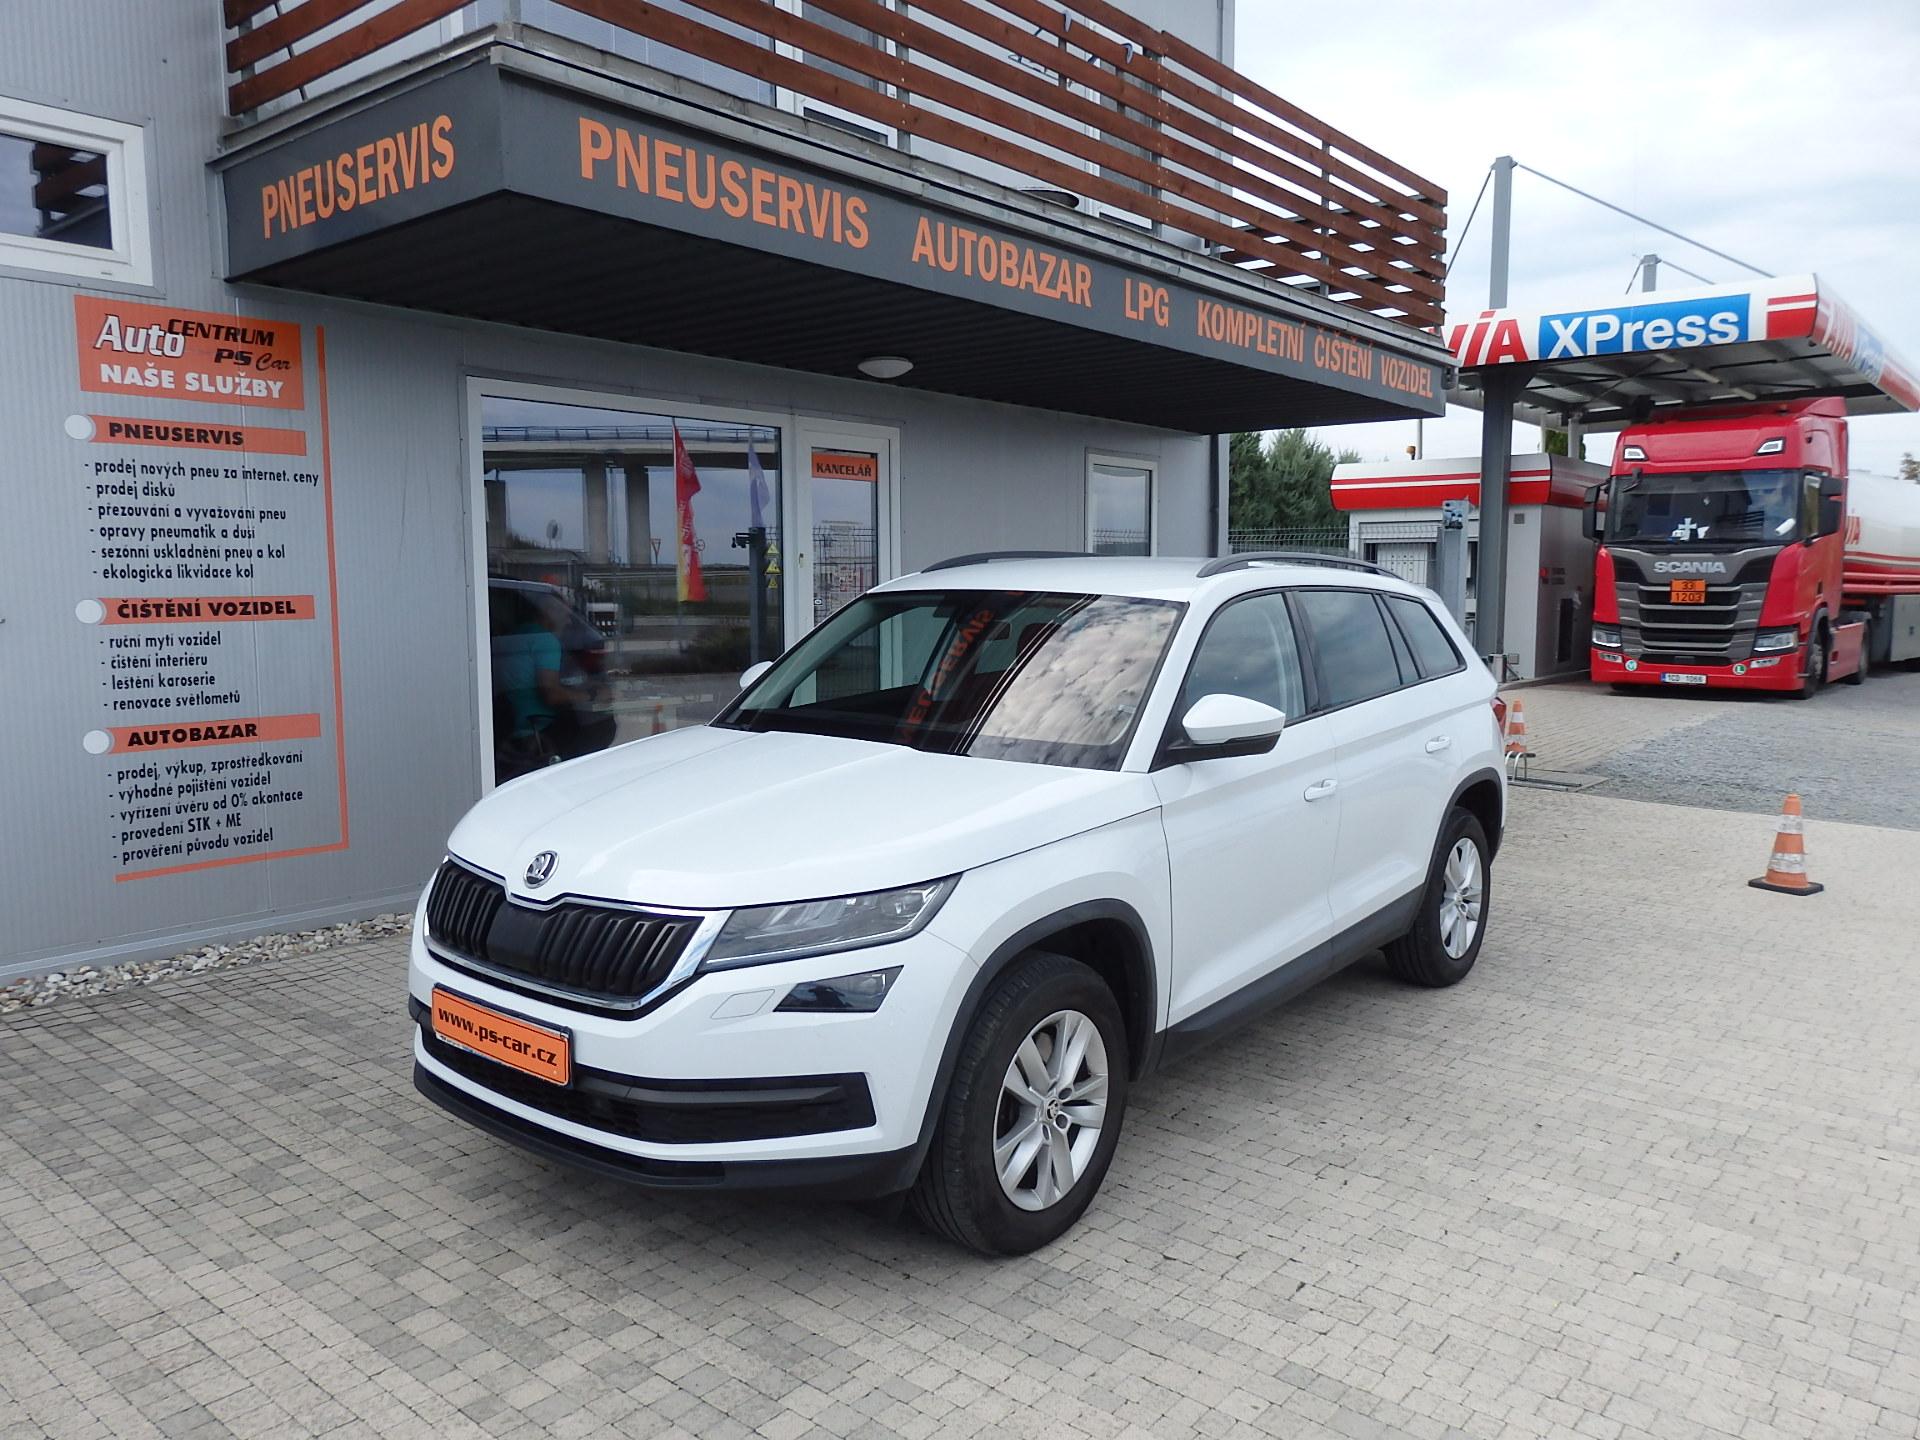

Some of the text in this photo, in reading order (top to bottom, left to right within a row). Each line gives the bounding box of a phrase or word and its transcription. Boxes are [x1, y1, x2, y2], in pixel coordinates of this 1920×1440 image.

[261, 114, 455, 240] PNEUSERVIS
[578, 116, 1434, 399] PNEUSERVIS AUTOBAZAR LPG KOMPLETNÍ ČIŠTĚNÍ VOZIDEL
[94, 314, 274, 358] Auto CENTRUM
[1546, 310, 1740, 360] XPress
[214, 348, 292, 372] PS Car
[100, 362, 284, 399] NAŠE SLUŽBY
[109, 422, 244, 446] PNEUSERVIS
[94, 460, 137, 479] prodej
[140, 461, 186, 480] nových
[190, 466, 219, 481] pneu
[223, 467, 237, 480] za
[293, 472, 320, 487] ceny
[815, 461, 873, 478] KANCELÁŘ
[96, 481, 176, 500] prodej disků
[97, 503, 287, 523] přezouvání a vyvažování pneu
[99, 527, 146, 542] opravy
[150, 523, 216, 542] pneumatik
[221, 528, 229, 539] a
[101, 543, 285, 561] sezónní uskladnění pneu a kol
[102, 563, 254, 583] ekologická likvidace kol
[1653, 561, 1726, 573] SCANIA
[1675, 592, 1702, 602] 1203
[1681, 581, 1695, 590] 33
[117, 599, 296, 619] ČIŠTĚNÍ VOZIDEL
[109, 634, 141, 649] ruční
[178, 631, 222, 647] vozidel
[110, 653, 208, 669] čištění interiéru
[112, 672, 216, 690] leštění karoserie
[113, 690, 241, 711] renovace světlometů
[127, 723, 258, 747] AUTOBAZAR
[210, 750, 303, 773] zprostředkování
[118, 771, 271, 804] výhodné pojištění vozidel
[120, 788, 303, 824] vyřízení úvěru od 0% akontace
[121, 819, 184, 846] provedení
[187, 816, 211, 833] STK
[226, 813, 242, 829] ME
[122, 828, 273, 865] prověření původu vozidel
[438, 1006, 558, 1067] www.ps-car.cz
